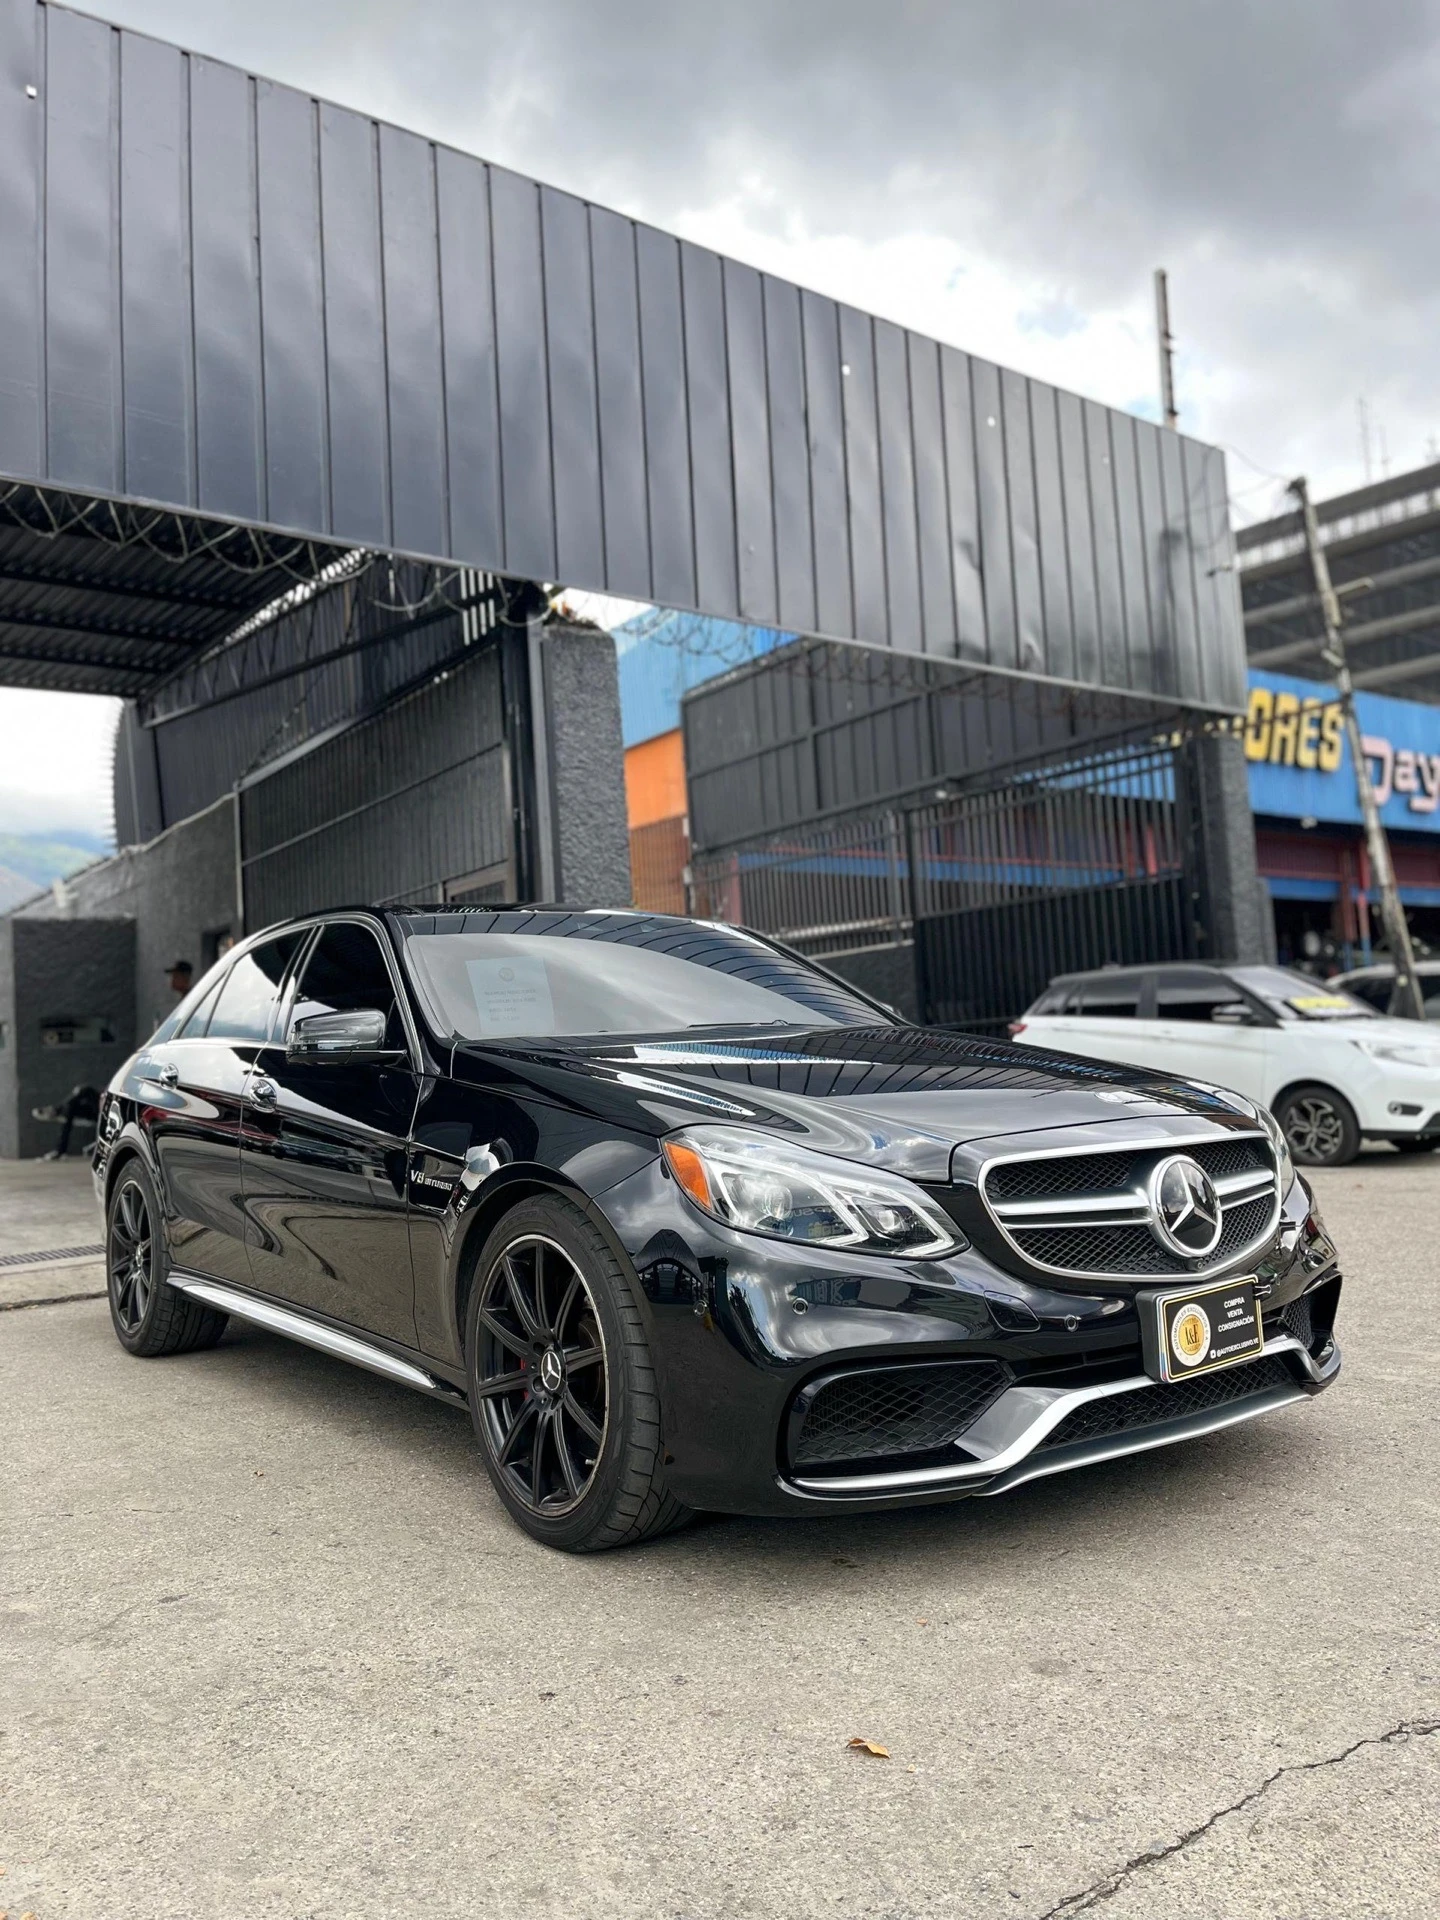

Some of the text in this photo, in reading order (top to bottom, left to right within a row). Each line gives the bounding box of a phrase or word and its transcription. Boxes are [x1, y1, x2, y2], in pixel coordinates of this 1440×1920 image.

[411, 1170, 425, 1183] V8
[1224, 1297, 1245, 1308] COMPRA
[1227, 1308, 1243, 1318] VENTA
[1218, 1316, 1254, 1332] CONSIGNACIÓN
